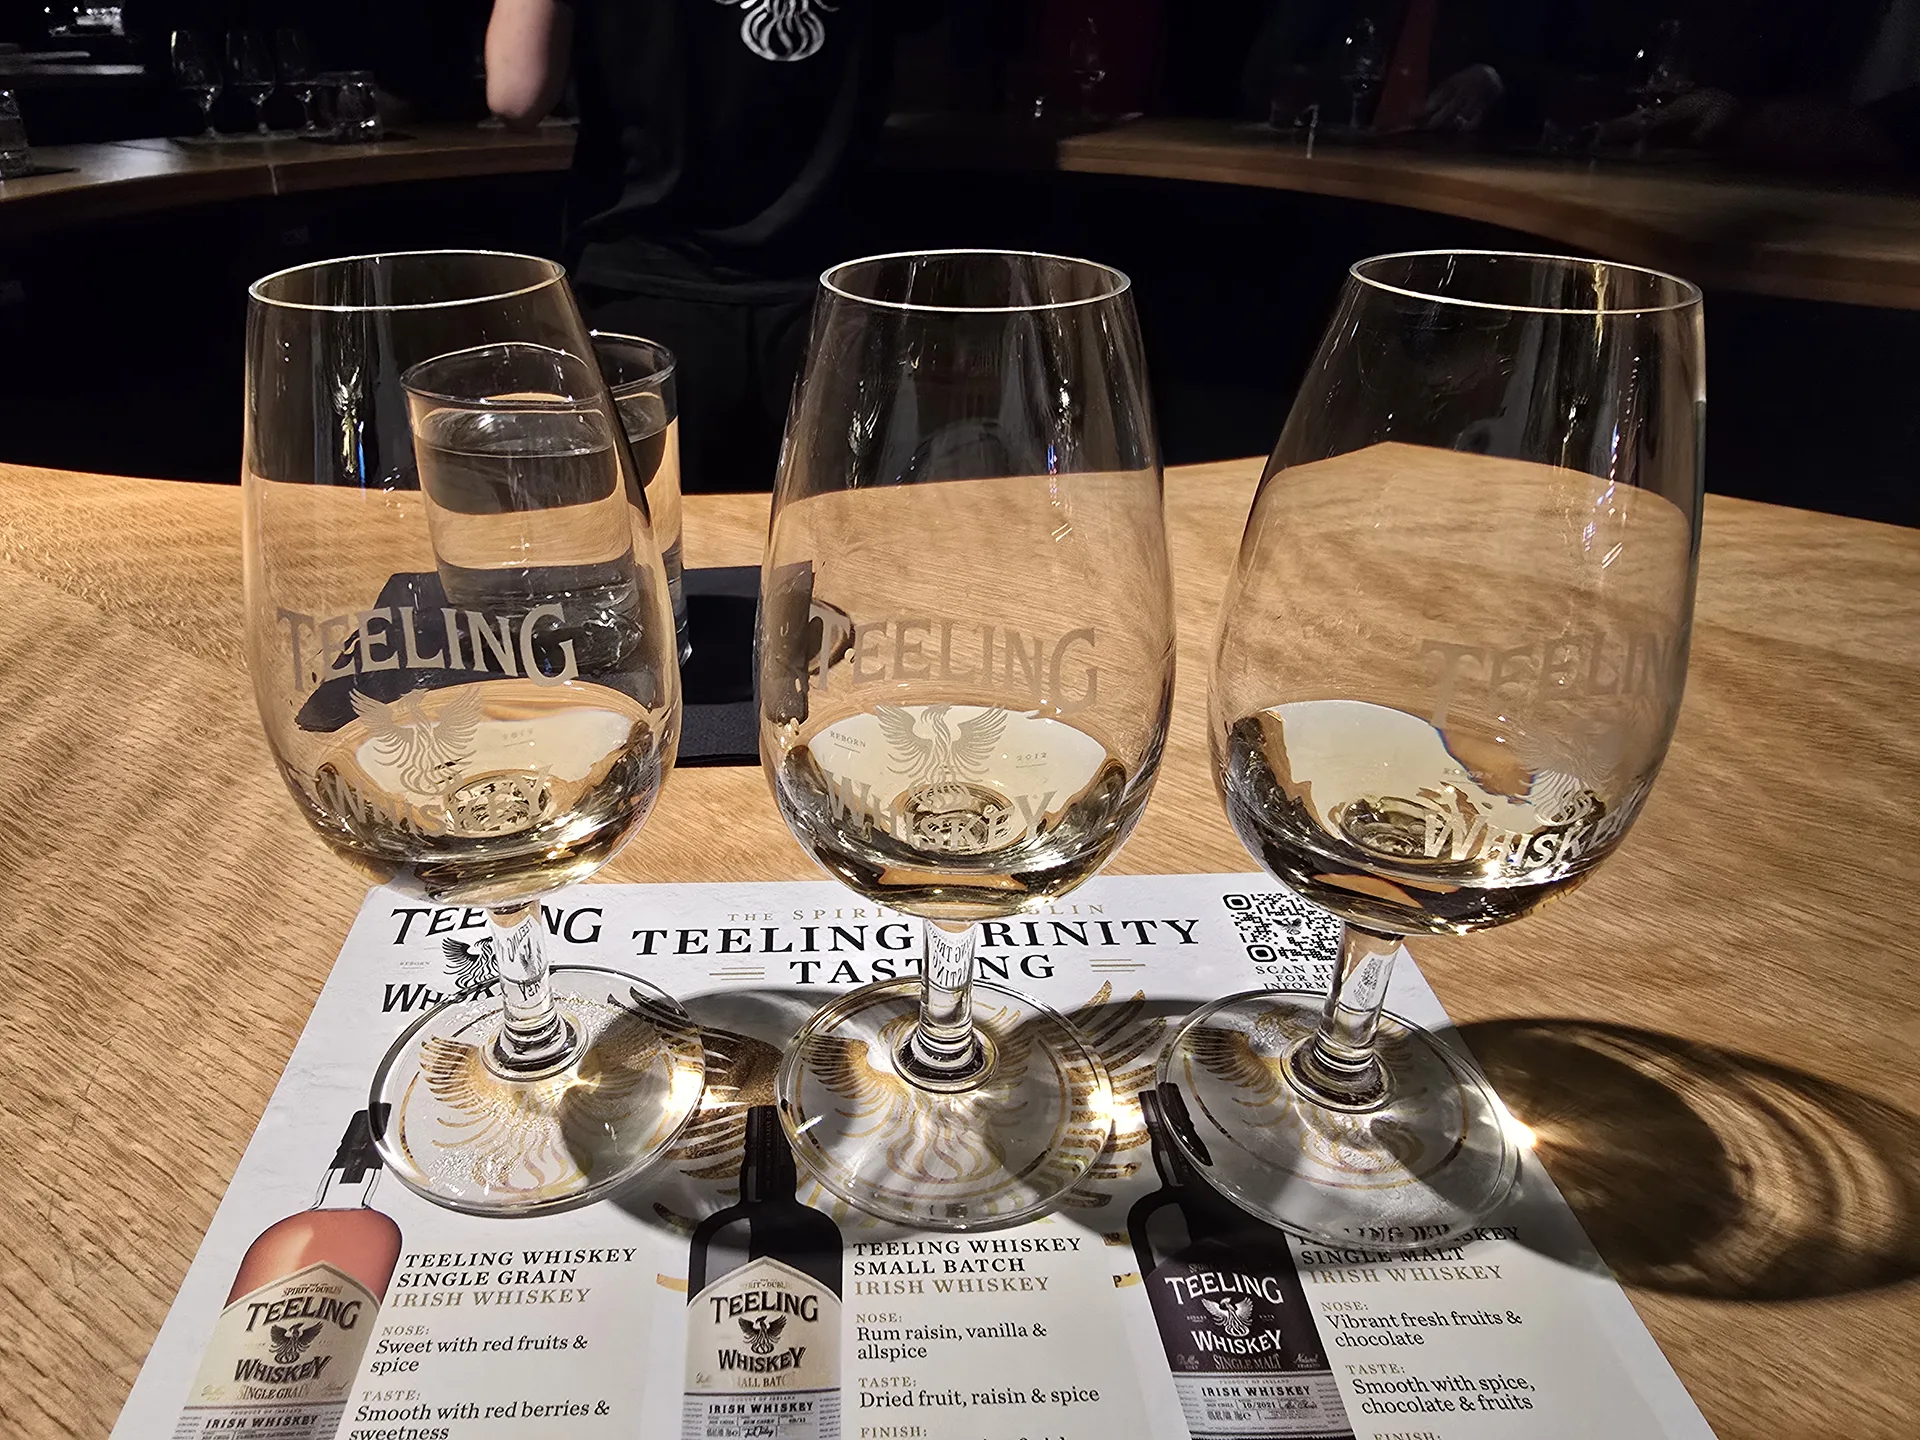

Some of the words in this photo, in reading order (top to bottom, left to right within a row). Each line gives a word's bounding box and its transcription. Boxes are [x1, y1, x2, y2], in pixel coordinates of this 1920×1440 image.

[276, 602, 580, 688] TEELING
[809, 616, 1099, 714] TEELING
[1421, 629, 1680, 727] TEELIN
[829, 729, 867, 749] REBORN
[1015, 750, 1048, 762] 2012
[825, 769, 1058, 852] WHISKEY
[390, 905, 604, 946] TEENG
[727, 912, 774, 922] THE
[631, 923, 915, 956] TEELING
[980, 919, 1200, 948] RINITY
[789, 954, 1055, 985] TASTNG
[1255, 964, 1306, 975] SCAN
[1276, 974, 1307, 982] FOR
[853, 1241, 961, 1257] TEELING
[968, 1237, 1082, 1254] WHISKEY
[1301, 1250, 1393, 1265] SINGLE
[1400, 1247, 1465, 1262] MALT
[403, 1251, 515, 1269] TEELING
[521, 1247, 637, 1264] WHISKEY
[853, 1260, 937, 1277] SMALL
[943, 1256, 1026, 1274] BATCH
[396, 1272, 490, 1288] SINGLE
[496, 1268, 578, 1286] GRAIN
[1309, 1268, 1381, 1284] IRISH
[1384, 1264, 1503, 1282] WHISKEY
[854, 1279, 925, 1296] IRISH
[933, 1275, 1050, 1294] WHISKEY
[1164, 1272, 1284, 1305] TEELING
[390, 1292, 463, 1309] IRISH
[472, 1288, 592, 1306] WHISKEY
[710, 1291, 819, 1324] TEELING
[1320, 1301, 1369, 1312] NOSE:
[245, 1296, 362, 1332] TEELING
[856, 1313, 903, 1323] NOSE:
[1325, 1312, 1399, 1330] Vibrant
[1400, 1310, 1448, 1328] fresh
[1450, 1310, 1503, 1327] fruits
[1505, 1310, 1522, 1325] &
[381, 1324, 430, 1336] NOSE:
[857, 1326, 901, 1342] Rum
[904, 1324, 963, 1342] raisin,
[964, 1322, 1030, 1339] vanilla
[1032, 1323, 1047, 1338] &
[1335, 1330, 1425, 1348] chocolate
[375, 1338, 433, 1355] Sweet
[437, 1336, 479, 1353] with
[483, 1335, 514, 1352] red
[516, 1335, 569, 1351] fruits
[571, 1336, 588, 1350] &
[1191, 1329, 1281, 1355] WHISKEY
[718, 1346, 807, 1373] WHISKEY
[857, 1344, 928, 1363] allspice
[1213, 1354, 1251, 1370] SINGLE
[1253, 1353, 1282, 1370] MALT
[233, 1355, 332, 1384] WHISKEY
[369, 1357, 420, 1376] spice
[1345, 1364, 1406, 1375] TASTE:
[858, 1377, 917, 1388] TASTE:
[1202, 1387, 1241, 1397] IRISH
[1245, 1385, 1311, 1397] WHISKEY
[1352, 1376, 1427, 1395] Smooth
[1430, 1375, 1474, 1393] with
[1477, 1374, 1536, 1396] spice,
[361, 1389, 421, 1402] TASTE:
[859, 1390, 915, 1409] Dried
[918, 1390, 968, 1408] fruit,
[971, 1388, 1027, 1405] raisin
[1031, 1388, 1047, 1403] &
[1050, 1387, 1100, 1407] spice
[1361, 1396, 1456, 1415] chocolate
[1459, 1396, 1475, 1412] &
[1478, 1393, 1534, 1412] fruits
[354, 1404, 432, 1423] Smooth
[436, 1403, 480, 1422] with
[484, 1402, 519, 1420] red
[521, 1400, 590, 1418] berries
[593, 1400, 610, 1416] &
[709, 1404, 746, 1414] IRISH
[750, 1401, 814, 1414] WHISKEY
[205, 1418, 248, 1429] IRISH
[251, 1415, 319, 1428] WHISKEY
[348, 1425, 450, 1440] sweetness
[859, 1426, 928, 1439] FINISH:
